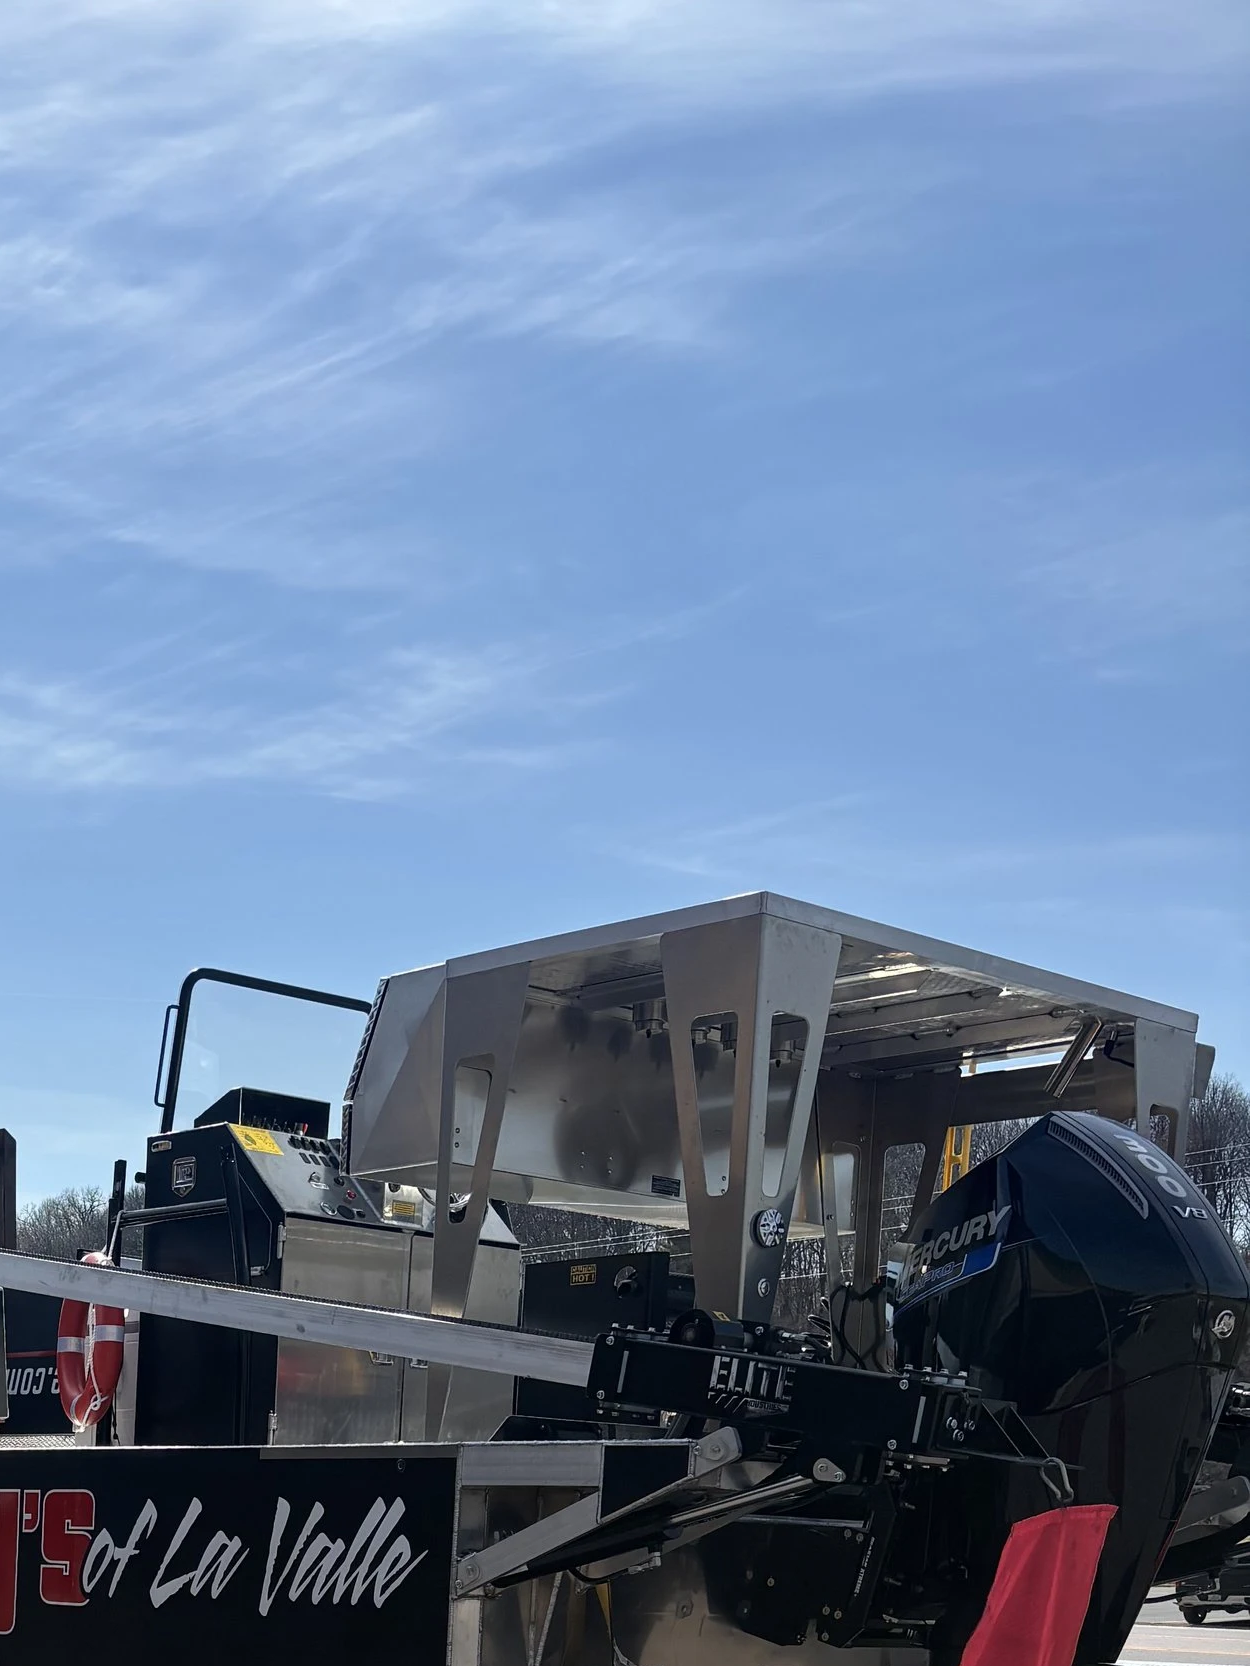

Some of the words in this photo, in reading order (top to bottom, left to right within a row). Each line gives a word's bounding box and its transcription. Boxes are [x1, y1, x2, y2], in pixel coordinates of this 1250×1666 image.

[1113, 1133, 1187, 1198] 300
[1171, 1205, 1208, 1219] V8
[710, 1355, 796, 1400] ELITE
[82, 1498, 158, 1598] of
[149, 1496, 250, 1609] La
[258, 1496, 429, 1617] Valle
